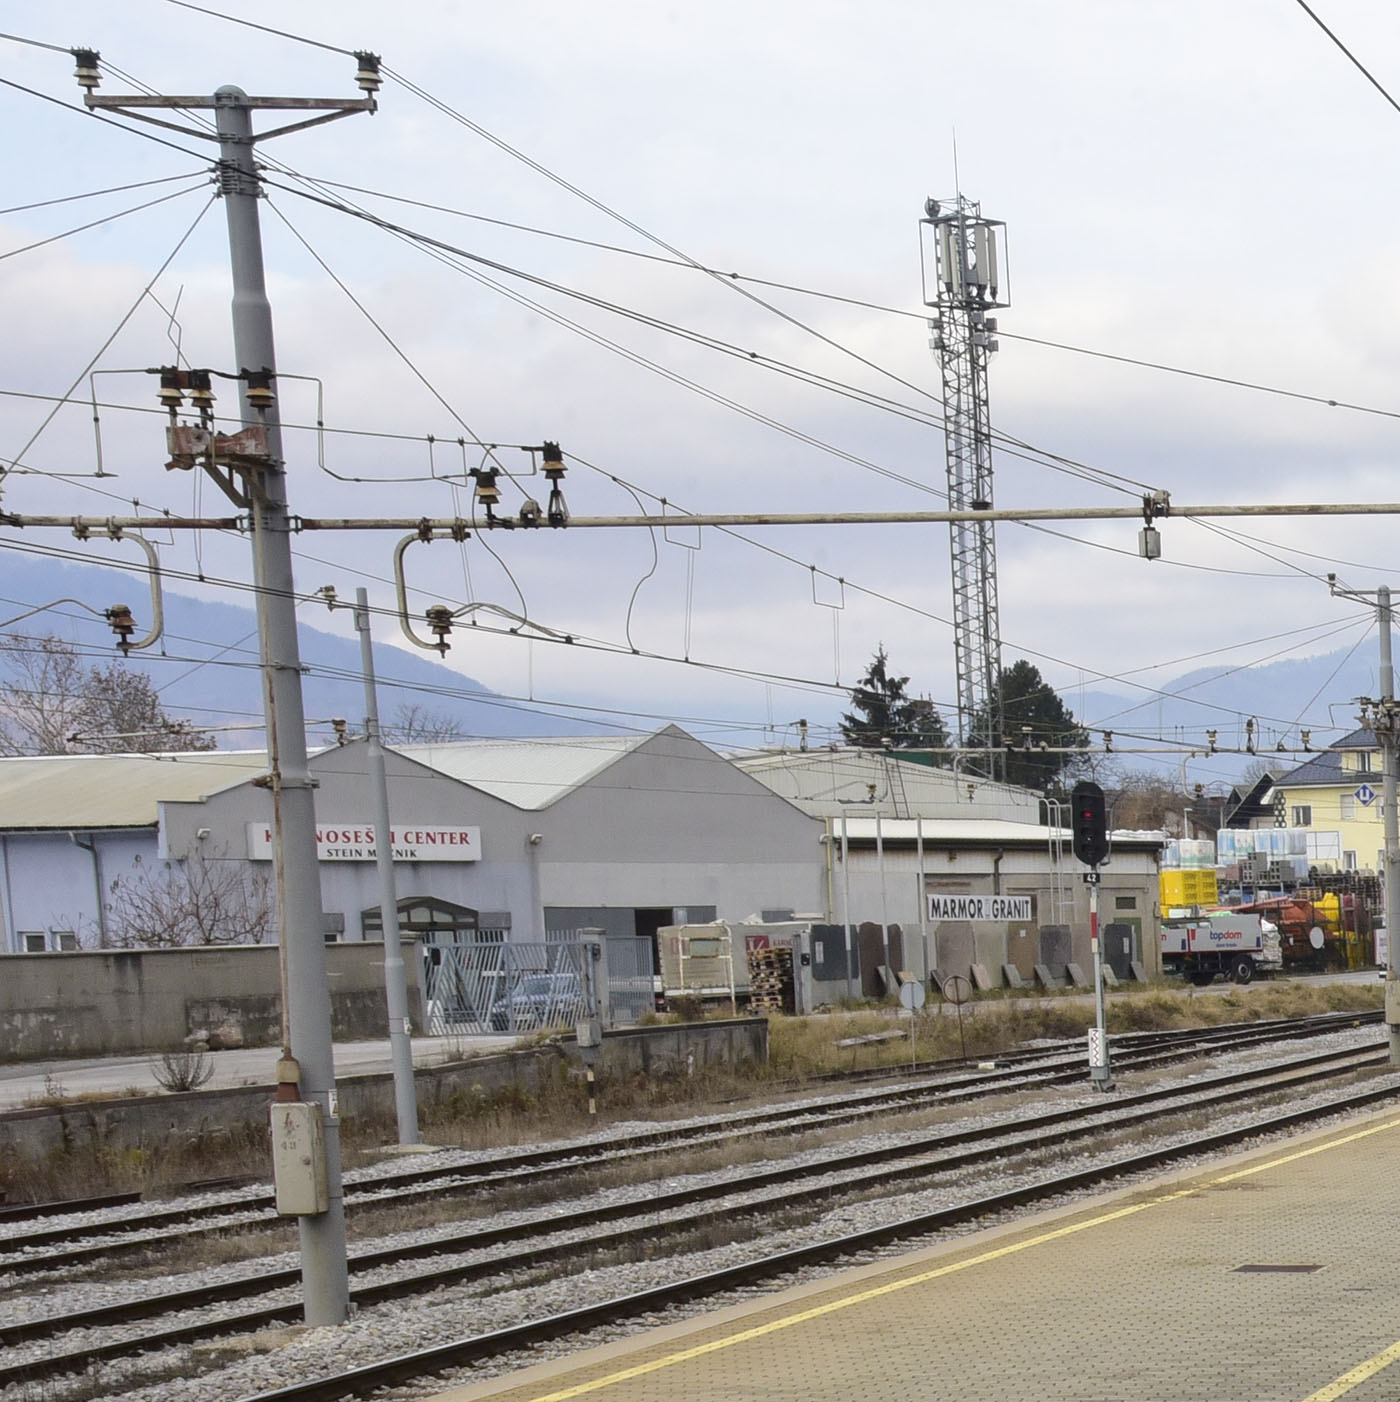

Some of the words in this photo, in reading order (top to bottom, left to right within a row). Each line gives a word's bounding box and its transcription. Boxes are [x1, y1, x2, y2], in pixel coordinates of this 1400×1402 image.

[403, 830, 471, 845] CENTER
[326, 848, 363, 858] STEIN
[1086, 873, 1097, 882] 42
[931, 898, 984, 919] MARMOR
[991, 898, 1029, 919] GRANIT
[1209, 930, 1242, 941] topdom
